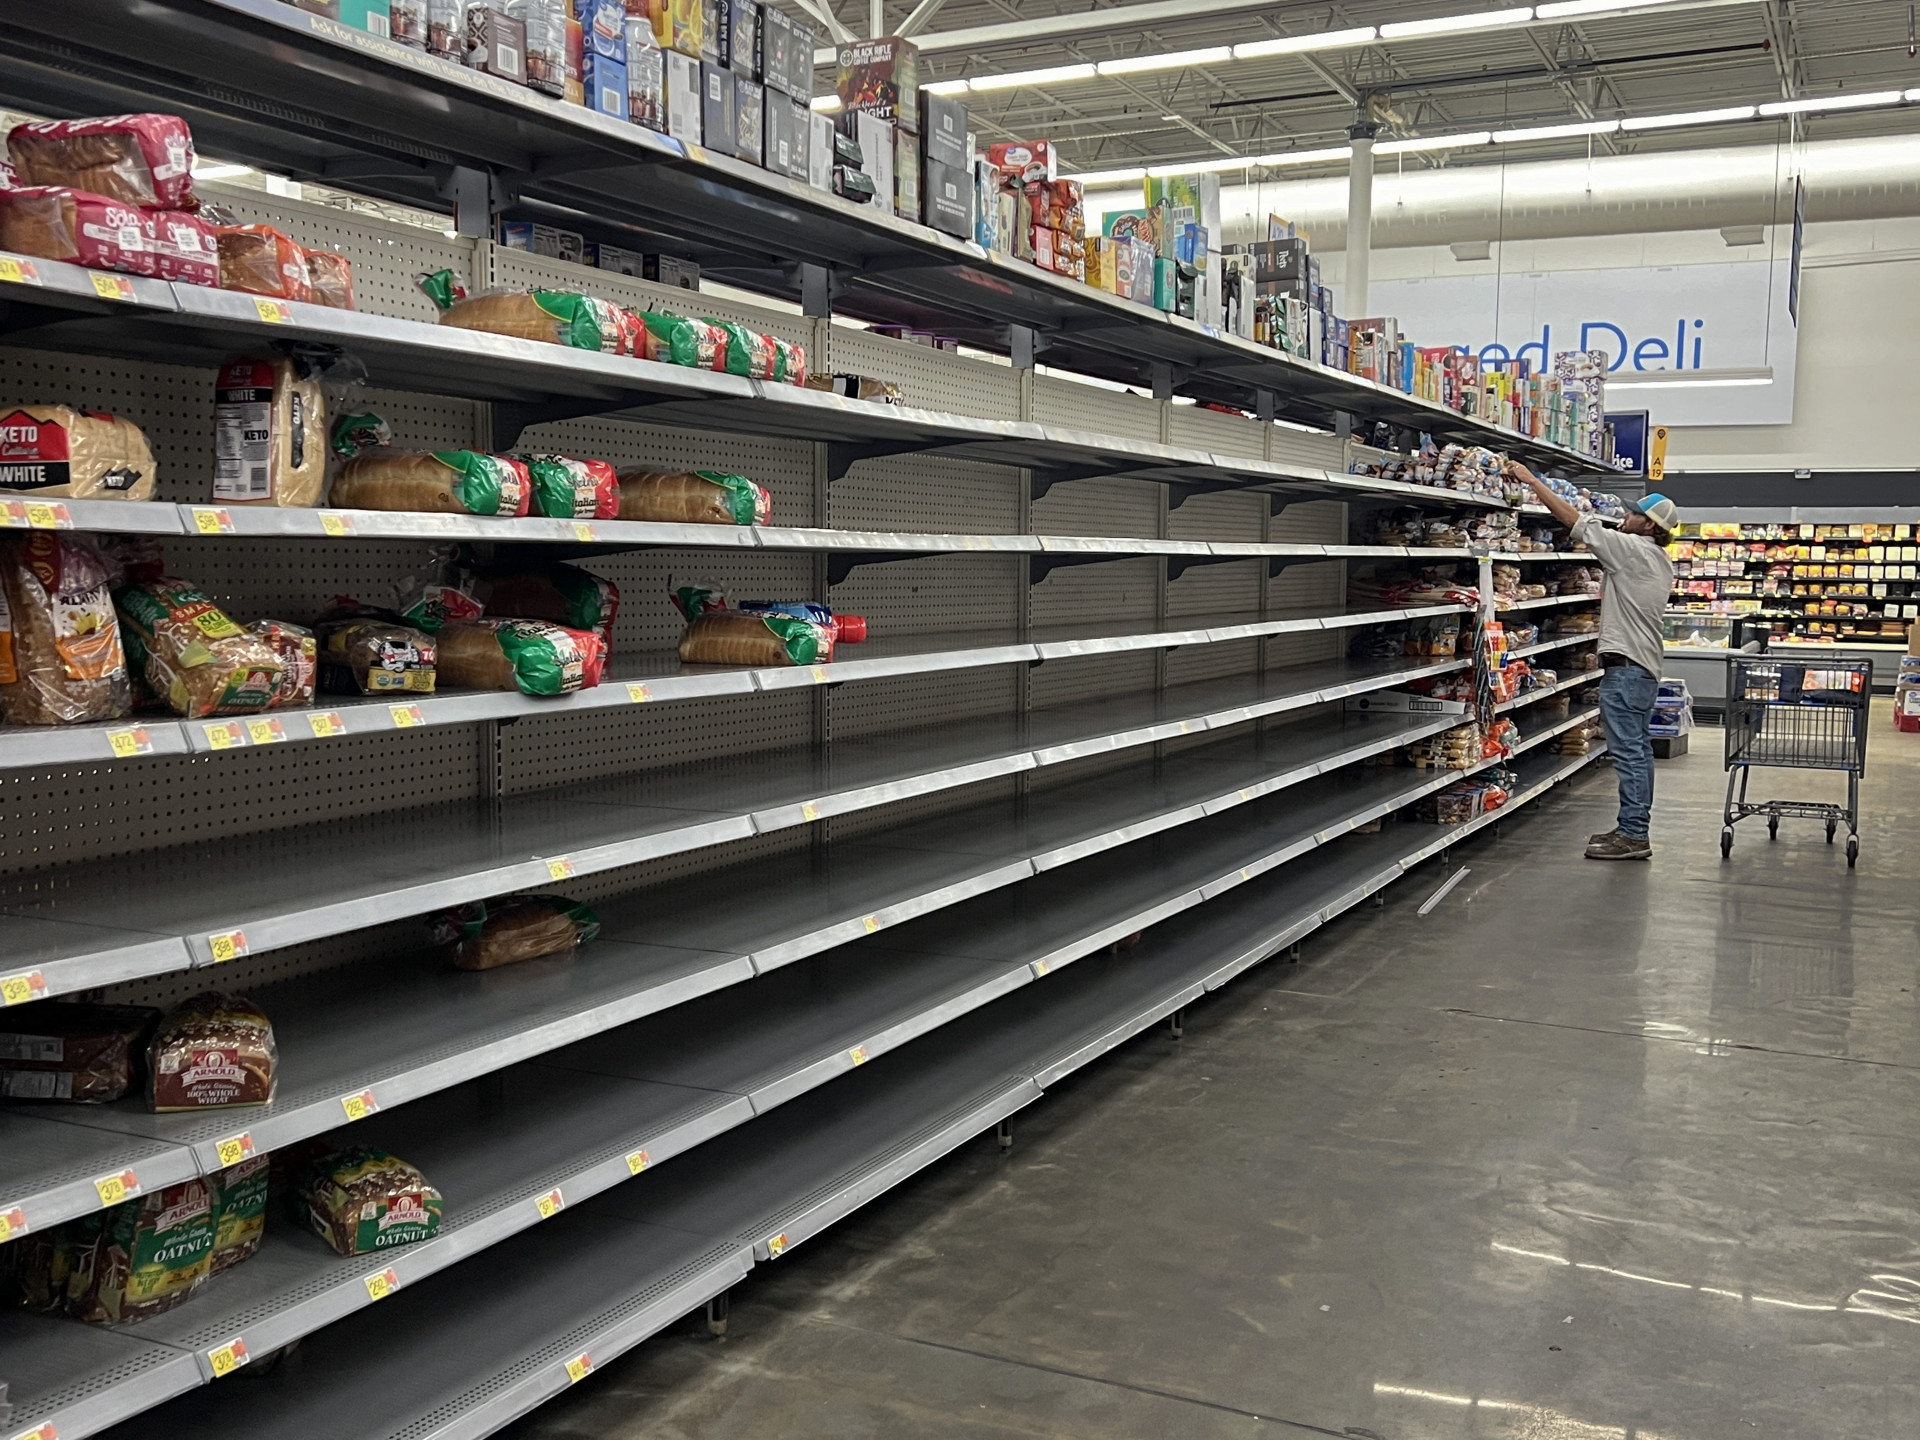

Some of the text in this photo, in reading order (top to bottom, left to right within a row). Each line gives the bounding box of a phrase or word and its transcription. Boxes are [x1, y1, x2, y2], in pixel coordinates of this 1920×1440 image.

[310, 17, 334, 36] Ask
[334, 26, 352, 42] for
[354, 35, 414, 63] assistance
[415, 55, 441, 73] with
[441, 62, 473, 83] items
[472, 75, 488, 87] on
[853, 46, 873, 59] BLACK
[874, 44, 892, 56] RIFLE
[1580, 318, 1704, 372] Deli
[227, 389, 256, 401] WHITE
[292, 396, 301, 425] KETO
[0, 426, 38, 443] KETO
[244, 430, 268, 441] KETO
[1612, 454, 1634, 469] rice
[1653, 457, 1662, 466] A
[0, 466, 46, 483] WHITE
[1652, 469, 1662, 478] 19
[197, 611, 221, 626] 80
[112, 735, 134, 750] 472
[193, 1067, 236, 1078] ARNOLD
[187, 1088, 241, 1099] 100% WHOLE
[198, 1096, 229, 1104] WHEAT
[388, 1211, 422, 1222] ARNOLD
[375, 1228, 428, 1247] OATNUT
[153, 1231, 213, 1264] OATNUT
